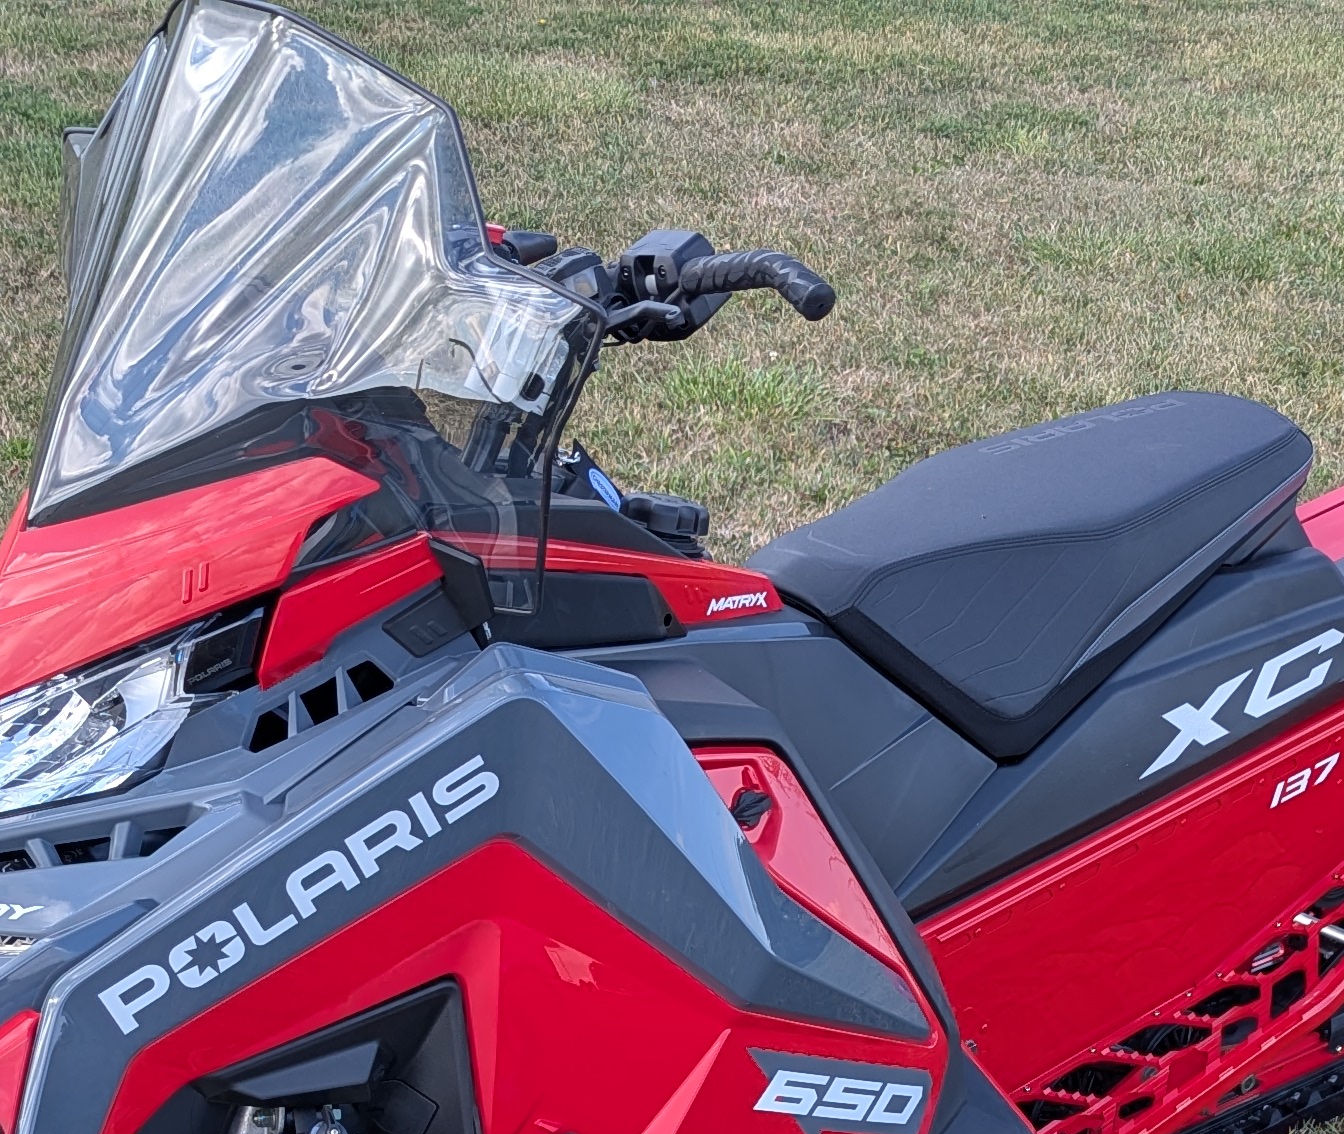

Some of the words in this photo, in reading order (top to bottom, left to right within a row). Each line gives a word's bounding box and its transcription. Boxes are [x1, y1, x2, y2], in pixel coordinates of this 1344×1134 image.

[978, 399, 1186, 456] POLARIS
[706, 591, 768, 616] MATRYX
[187, 658, 233, 685] POLARIS
[1269, 752, 1341, 809] 137
[97, 754, 500, 1036] POLARIS
[753, 1069, 924, 1125] 650
